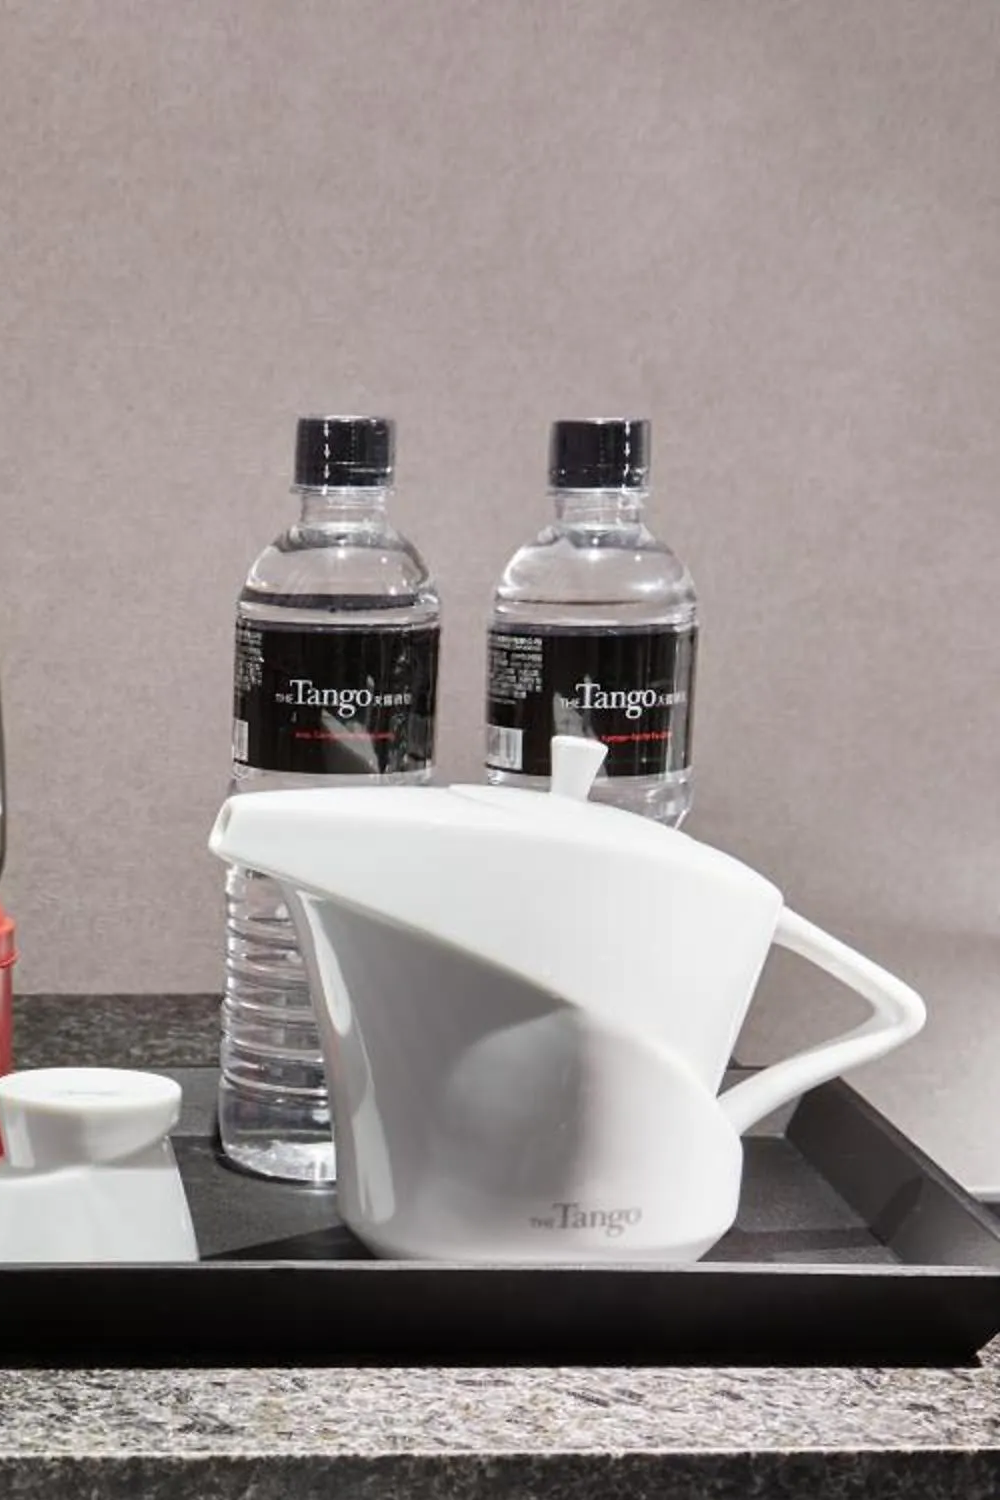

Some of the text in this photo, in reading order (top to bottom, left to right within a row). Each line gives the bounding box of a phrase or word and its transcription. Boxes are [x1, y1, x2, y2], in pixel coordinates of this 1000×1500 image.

[289, 679, 372, 718] Tango
[575, 683, 657, 719] Tango
[552, 1201, 643, 1239] Tango
